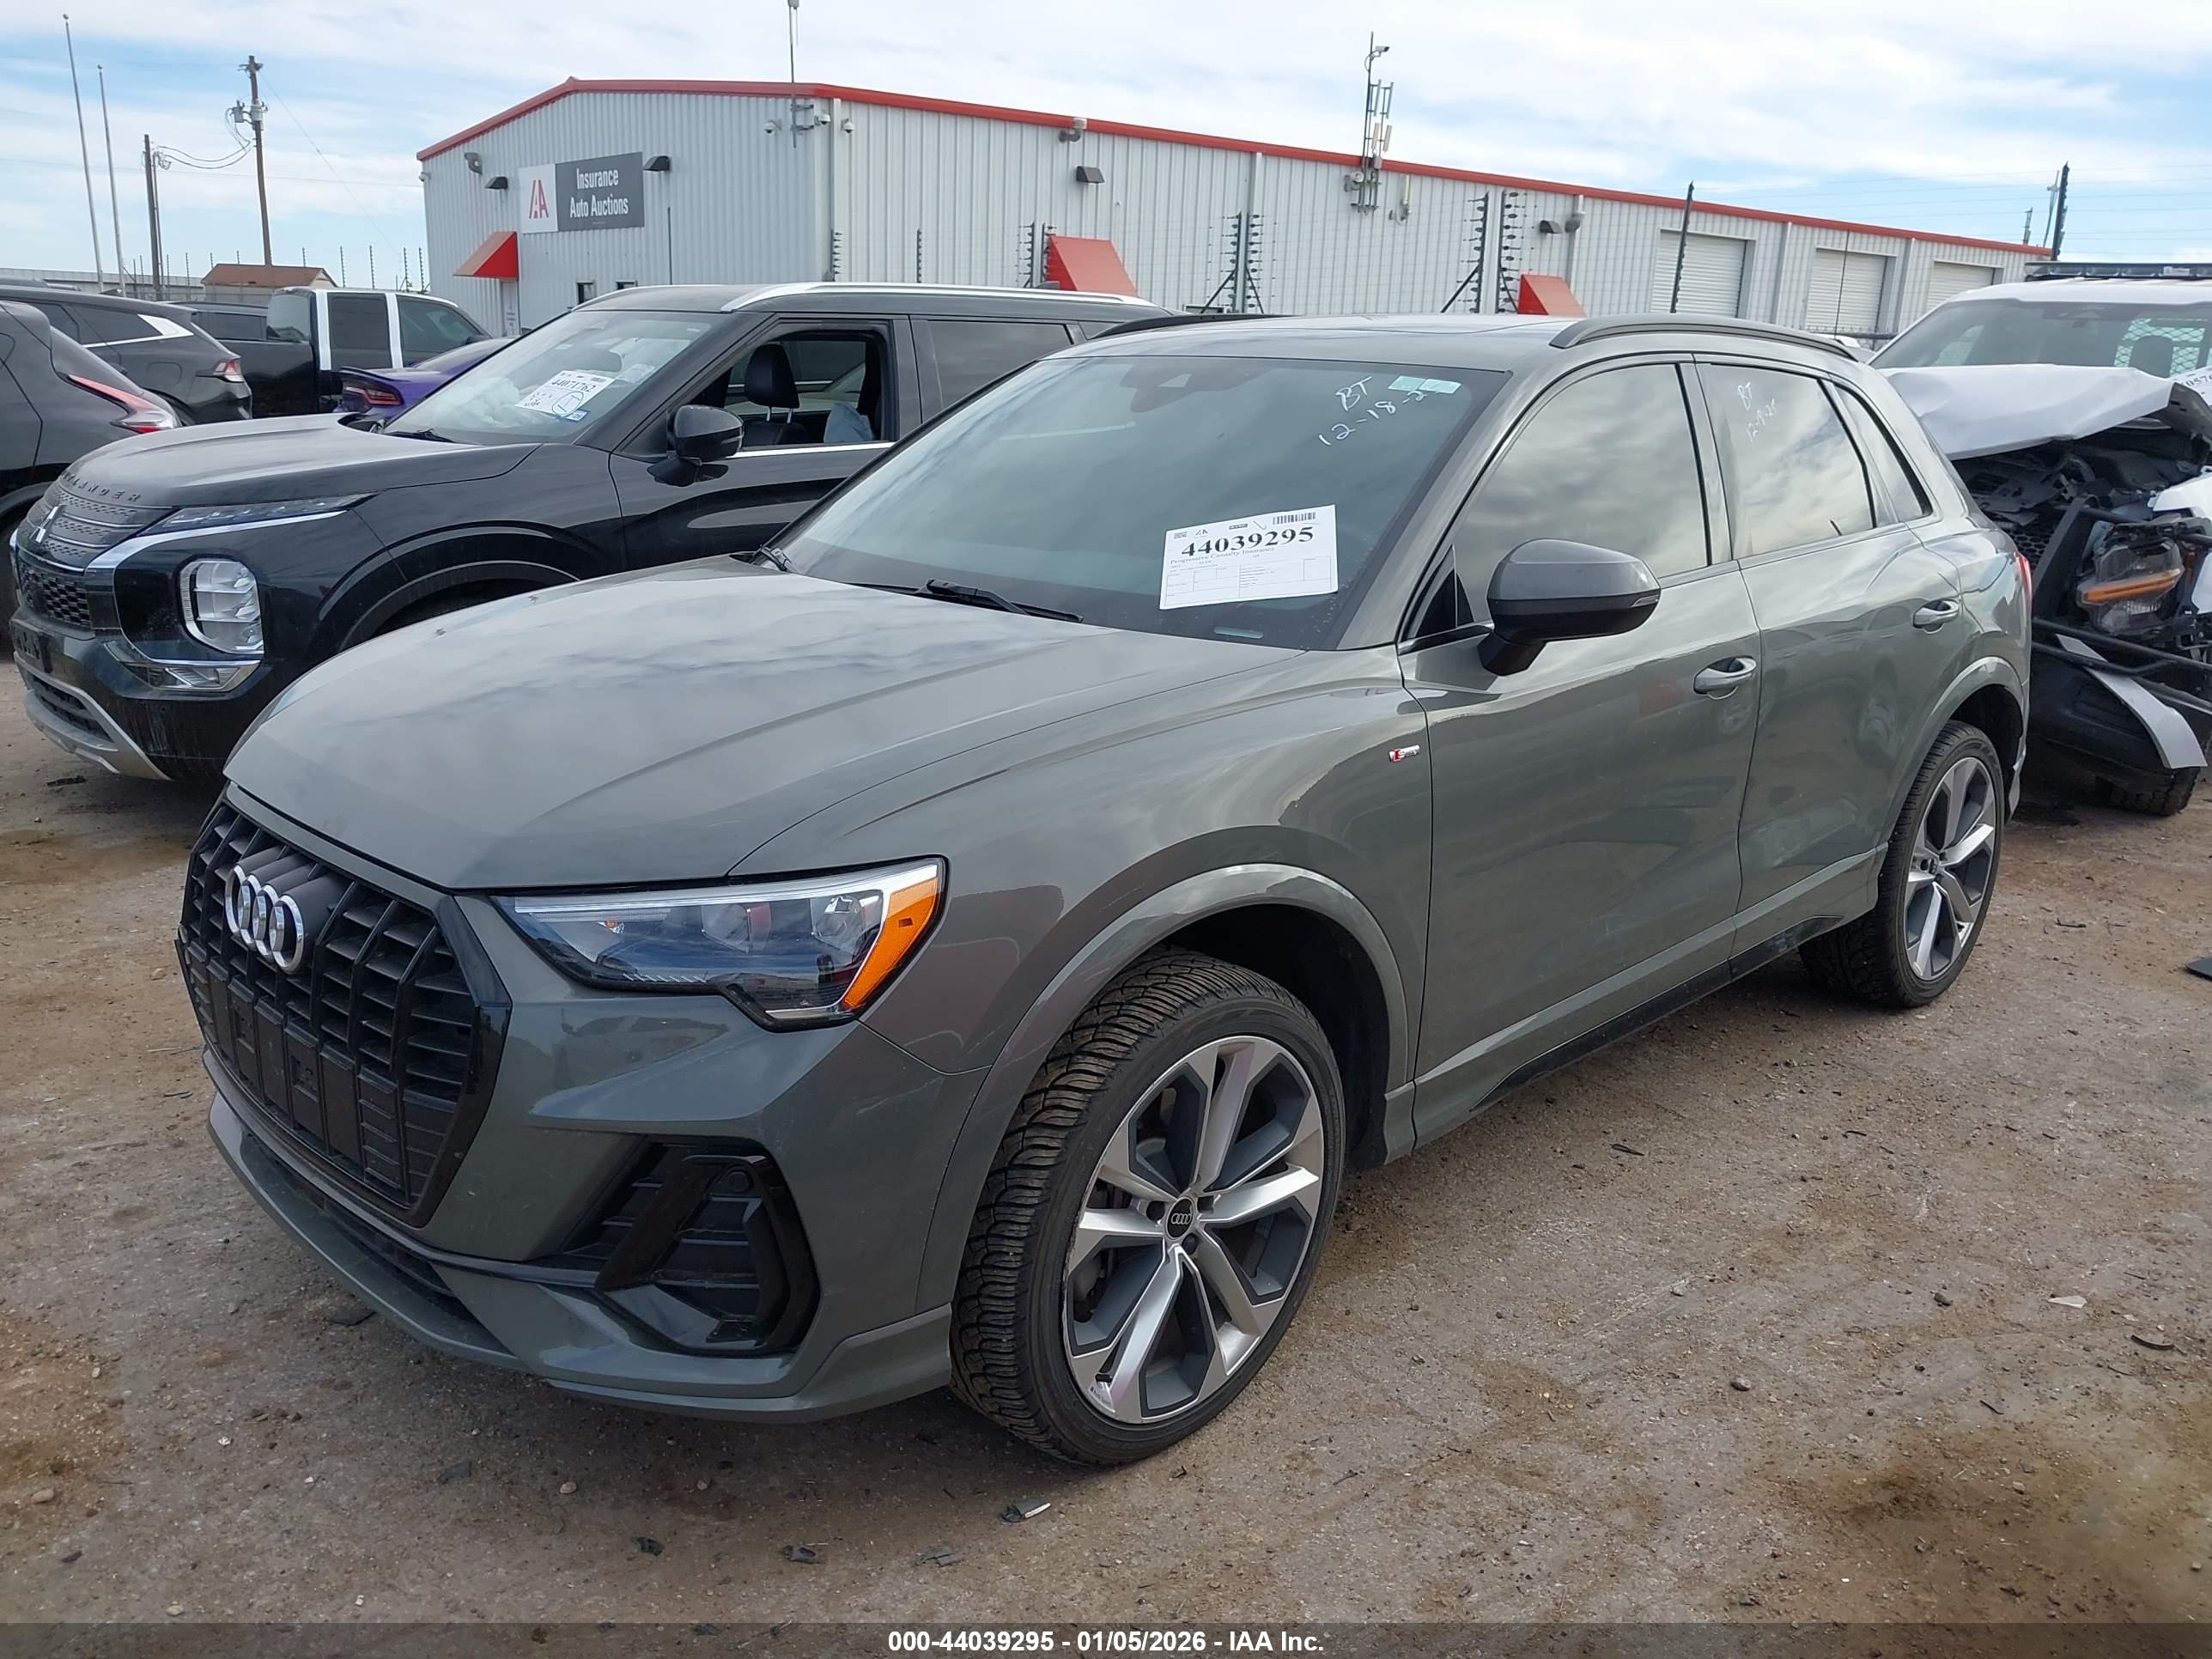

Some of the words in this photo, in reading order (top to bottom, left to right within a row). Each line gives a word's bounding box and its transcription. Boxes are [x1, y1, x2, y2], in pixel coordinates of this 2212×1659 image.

[576, 168, 619, 190] Insurance
[569, 197, 589, 218] Auto
[590, 193, 629, 216] Auctions
[1318, 390, 1429, 447] 12-18-2
[1182, 526, 1315, 557] 44039295
